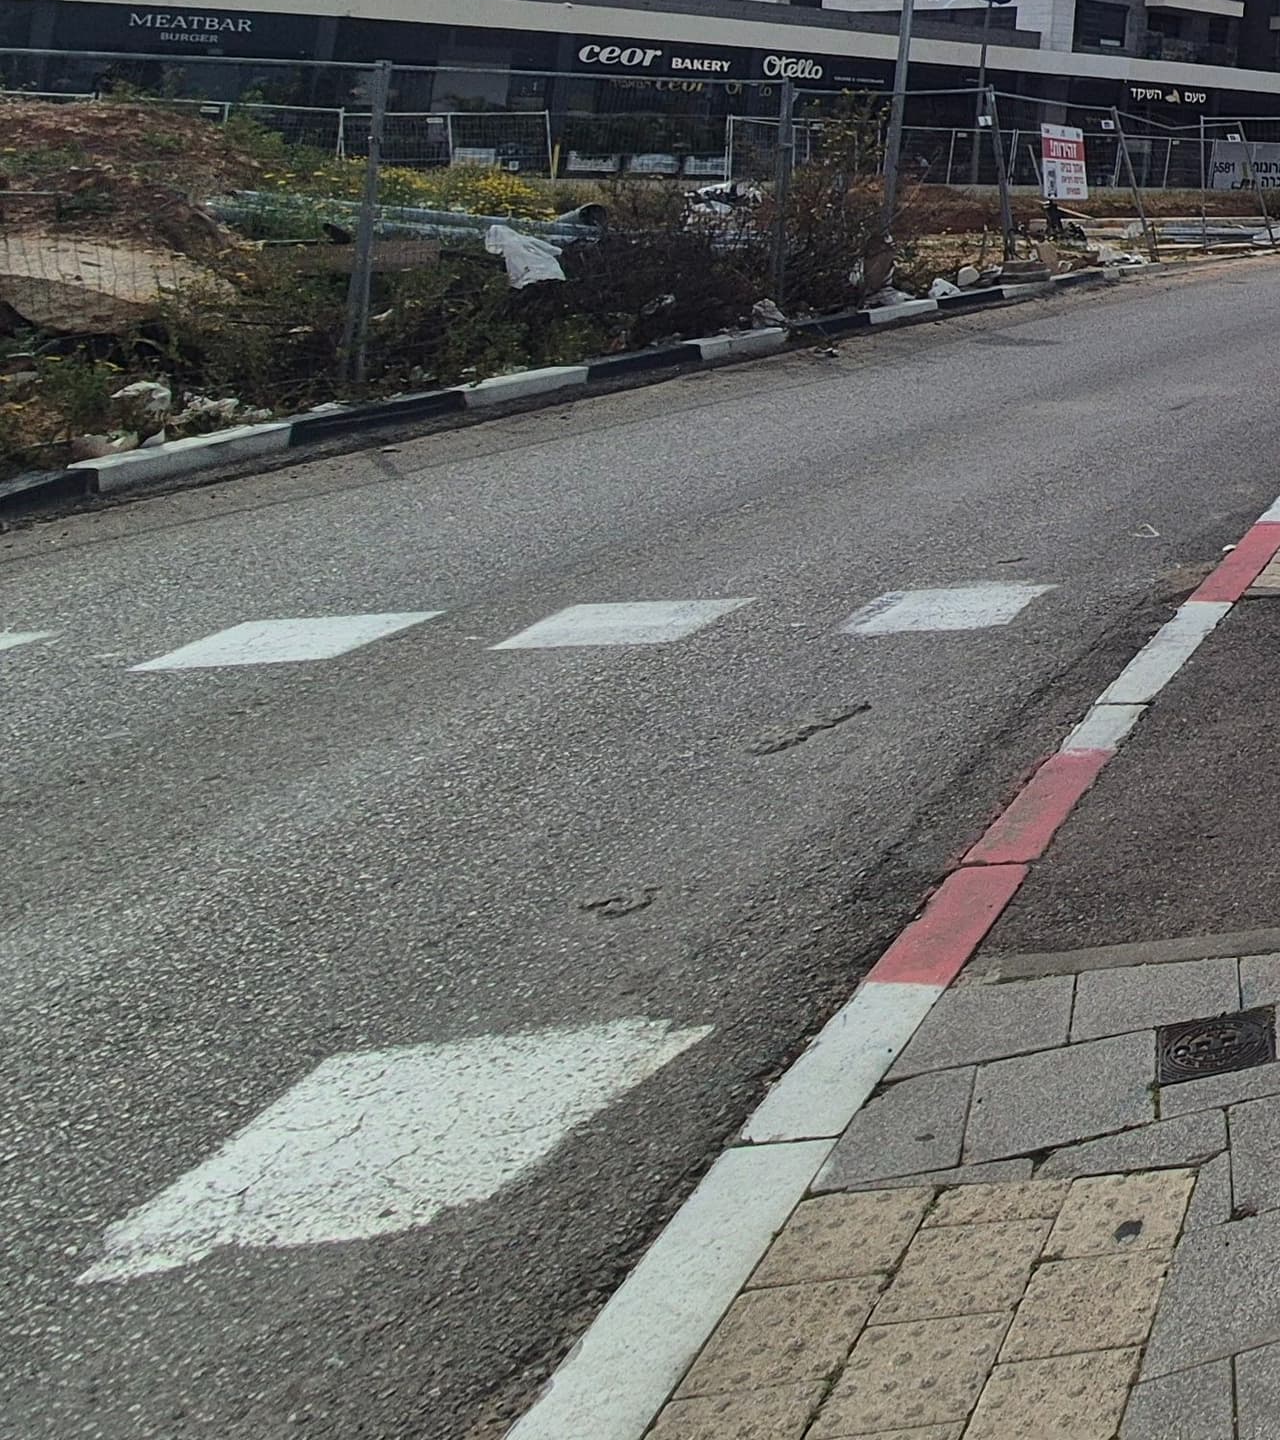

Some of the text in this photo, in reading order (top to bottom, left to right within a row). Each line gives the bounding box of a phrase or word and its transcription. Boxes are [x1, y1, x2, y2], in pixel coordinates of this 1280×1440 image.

[129, 13, 252, 32] MEATBAR
[160, 32, 218, 42] BURGER
[578, 45, 731, 72] ceor BAKERY
[763, 55, 823, 79] Otello
[1130, 87, 1162, 101] השקד
